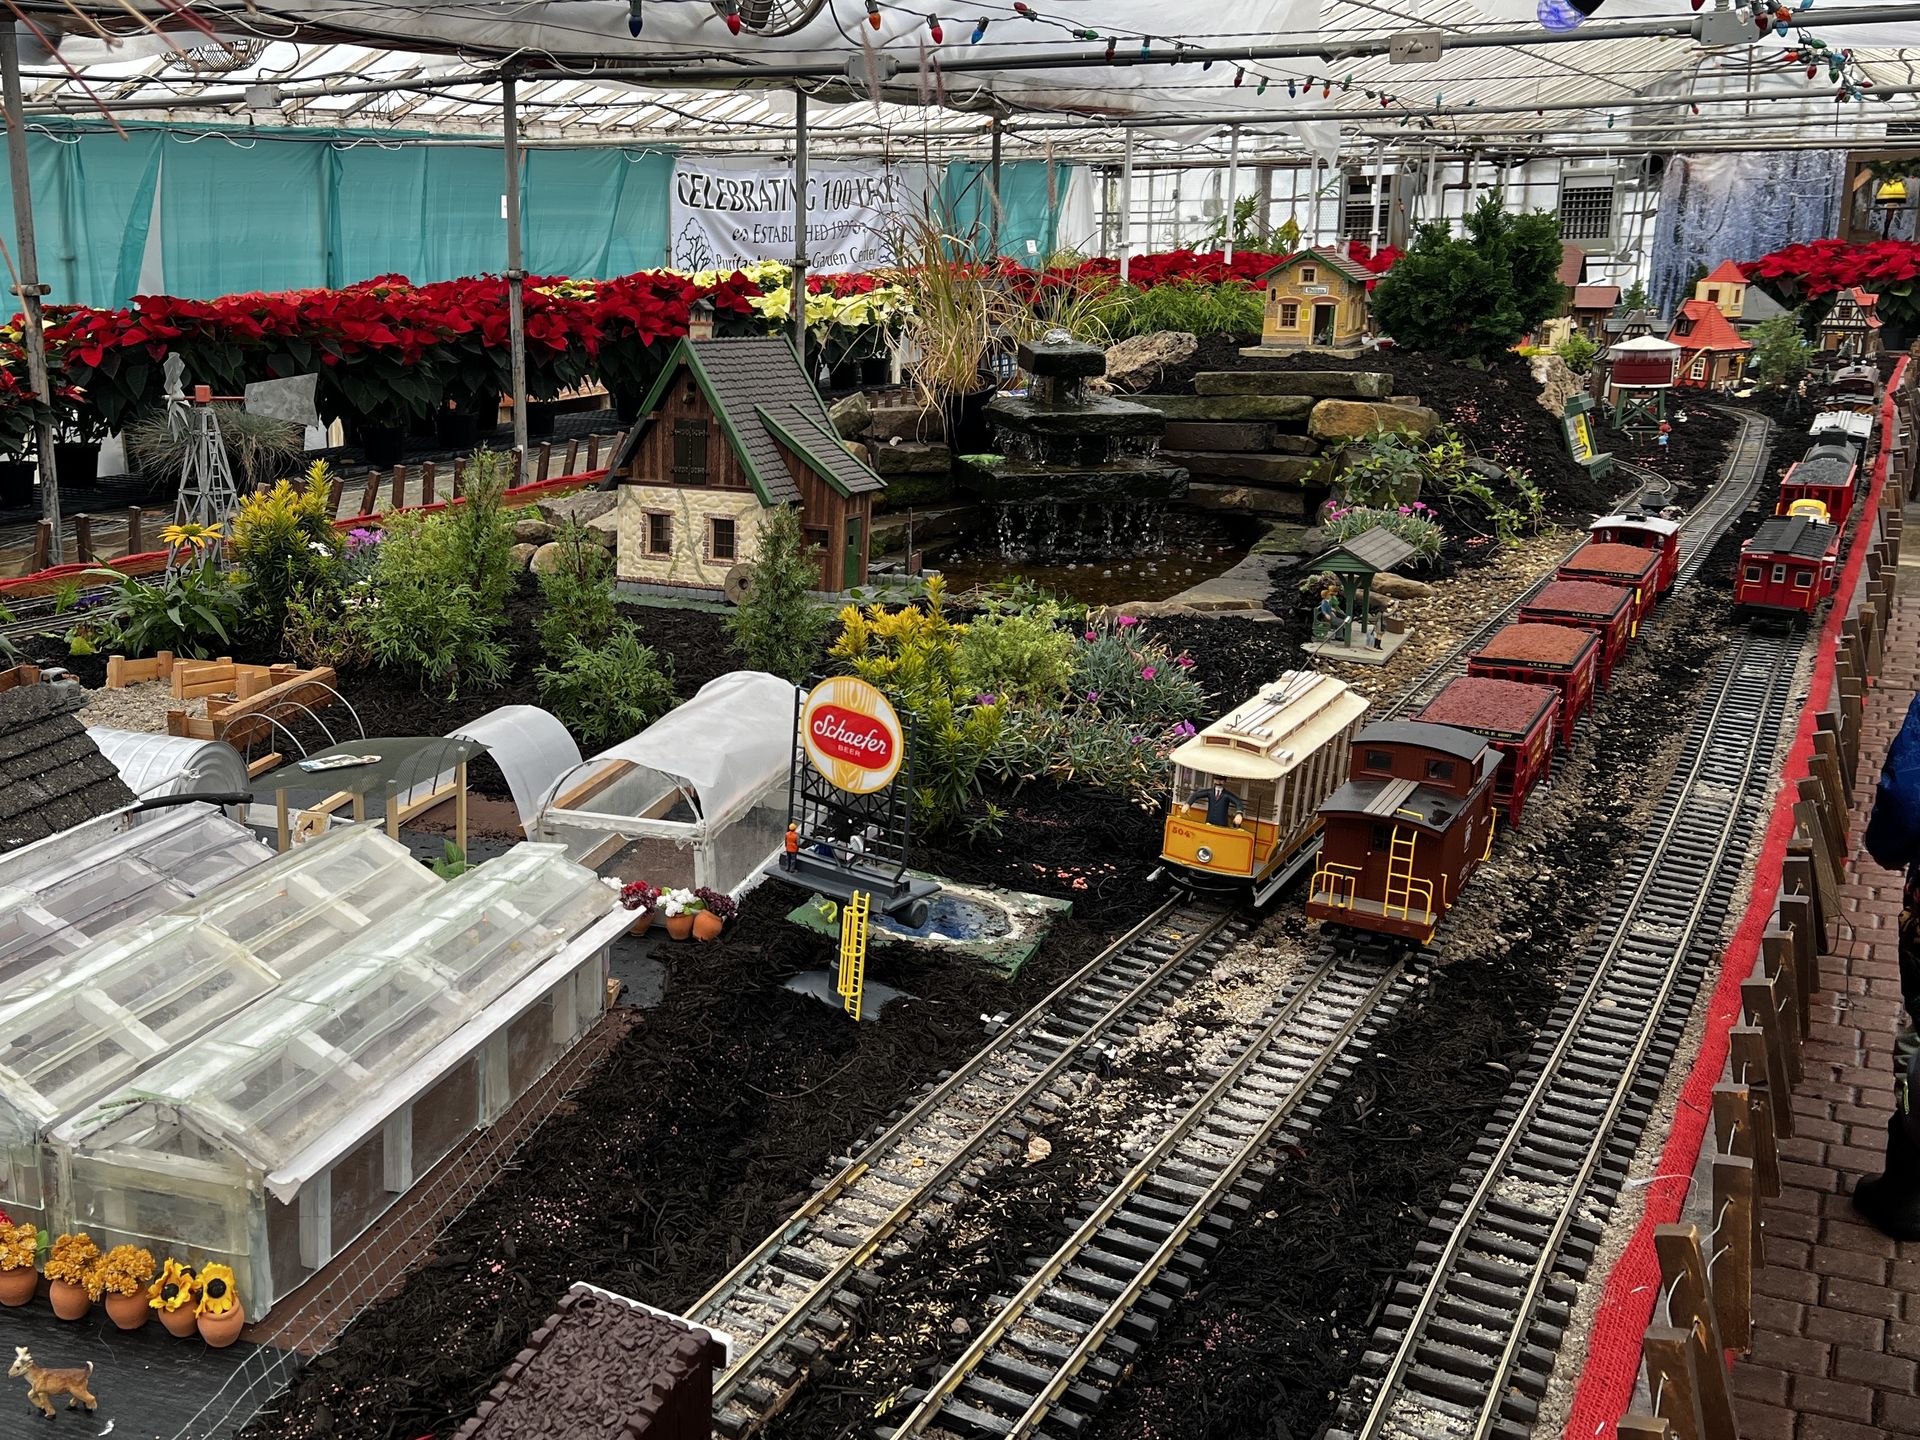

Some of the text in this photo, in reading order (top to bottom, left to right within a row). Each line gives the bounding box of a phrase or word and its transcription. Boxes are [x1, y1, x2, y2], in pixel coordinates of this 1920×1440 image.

[677, 172, 816, 212] CELEBRATING
[822, 178, 852, 211] 100
[812, 249, 848, 269] Garden
[813, 714, 887, 755] Schaefer
[838, 744, 861, 757] BEER
